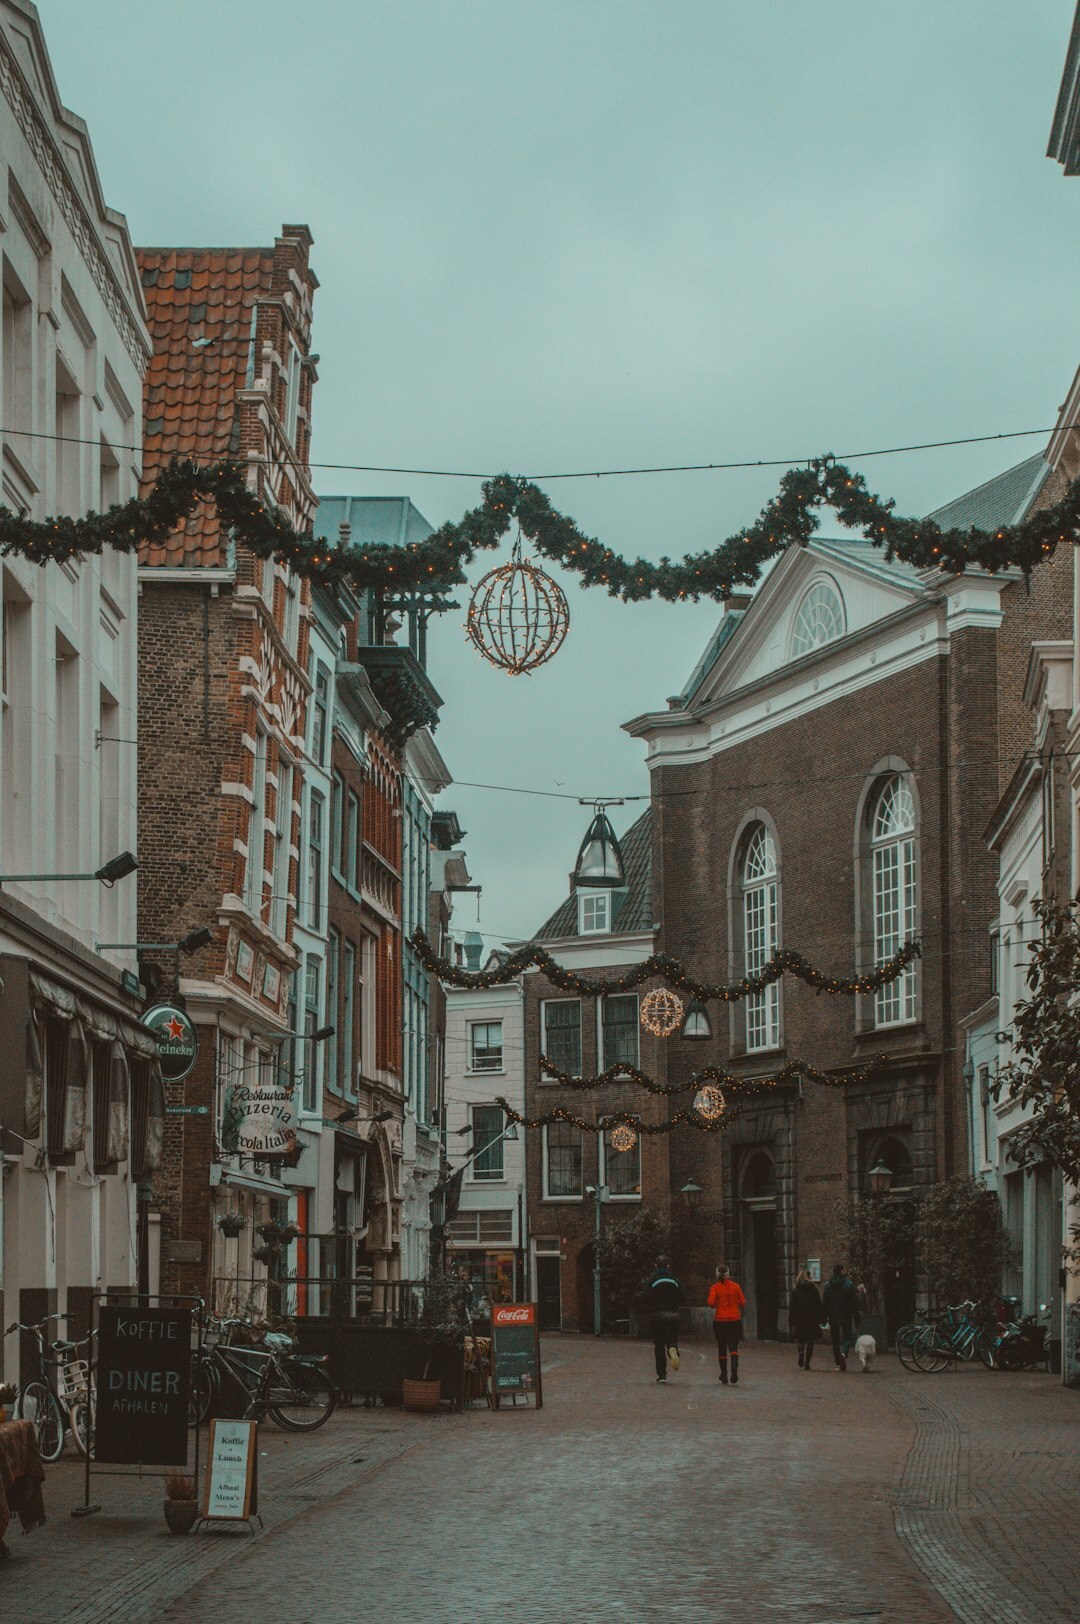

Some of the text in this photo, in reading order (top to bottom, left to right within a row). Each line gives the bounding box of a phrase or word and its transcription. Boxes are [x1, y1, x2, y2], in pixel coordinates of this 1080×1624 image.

[231, 1086, 295, 1102] Restaurant
[228, 1103, 292, 1125] Pizzeria
[265, 1128, 295, 1149] Italia
[116, 1317, 179, 1341] KOFFIE
[109, 1369, 181, 1396] DINER
[112, 1397, 168, 1415] AFHALEN
[221, 1436, 245, 1445] Koffie
[218, 1454, 242, 1463] Lunch
